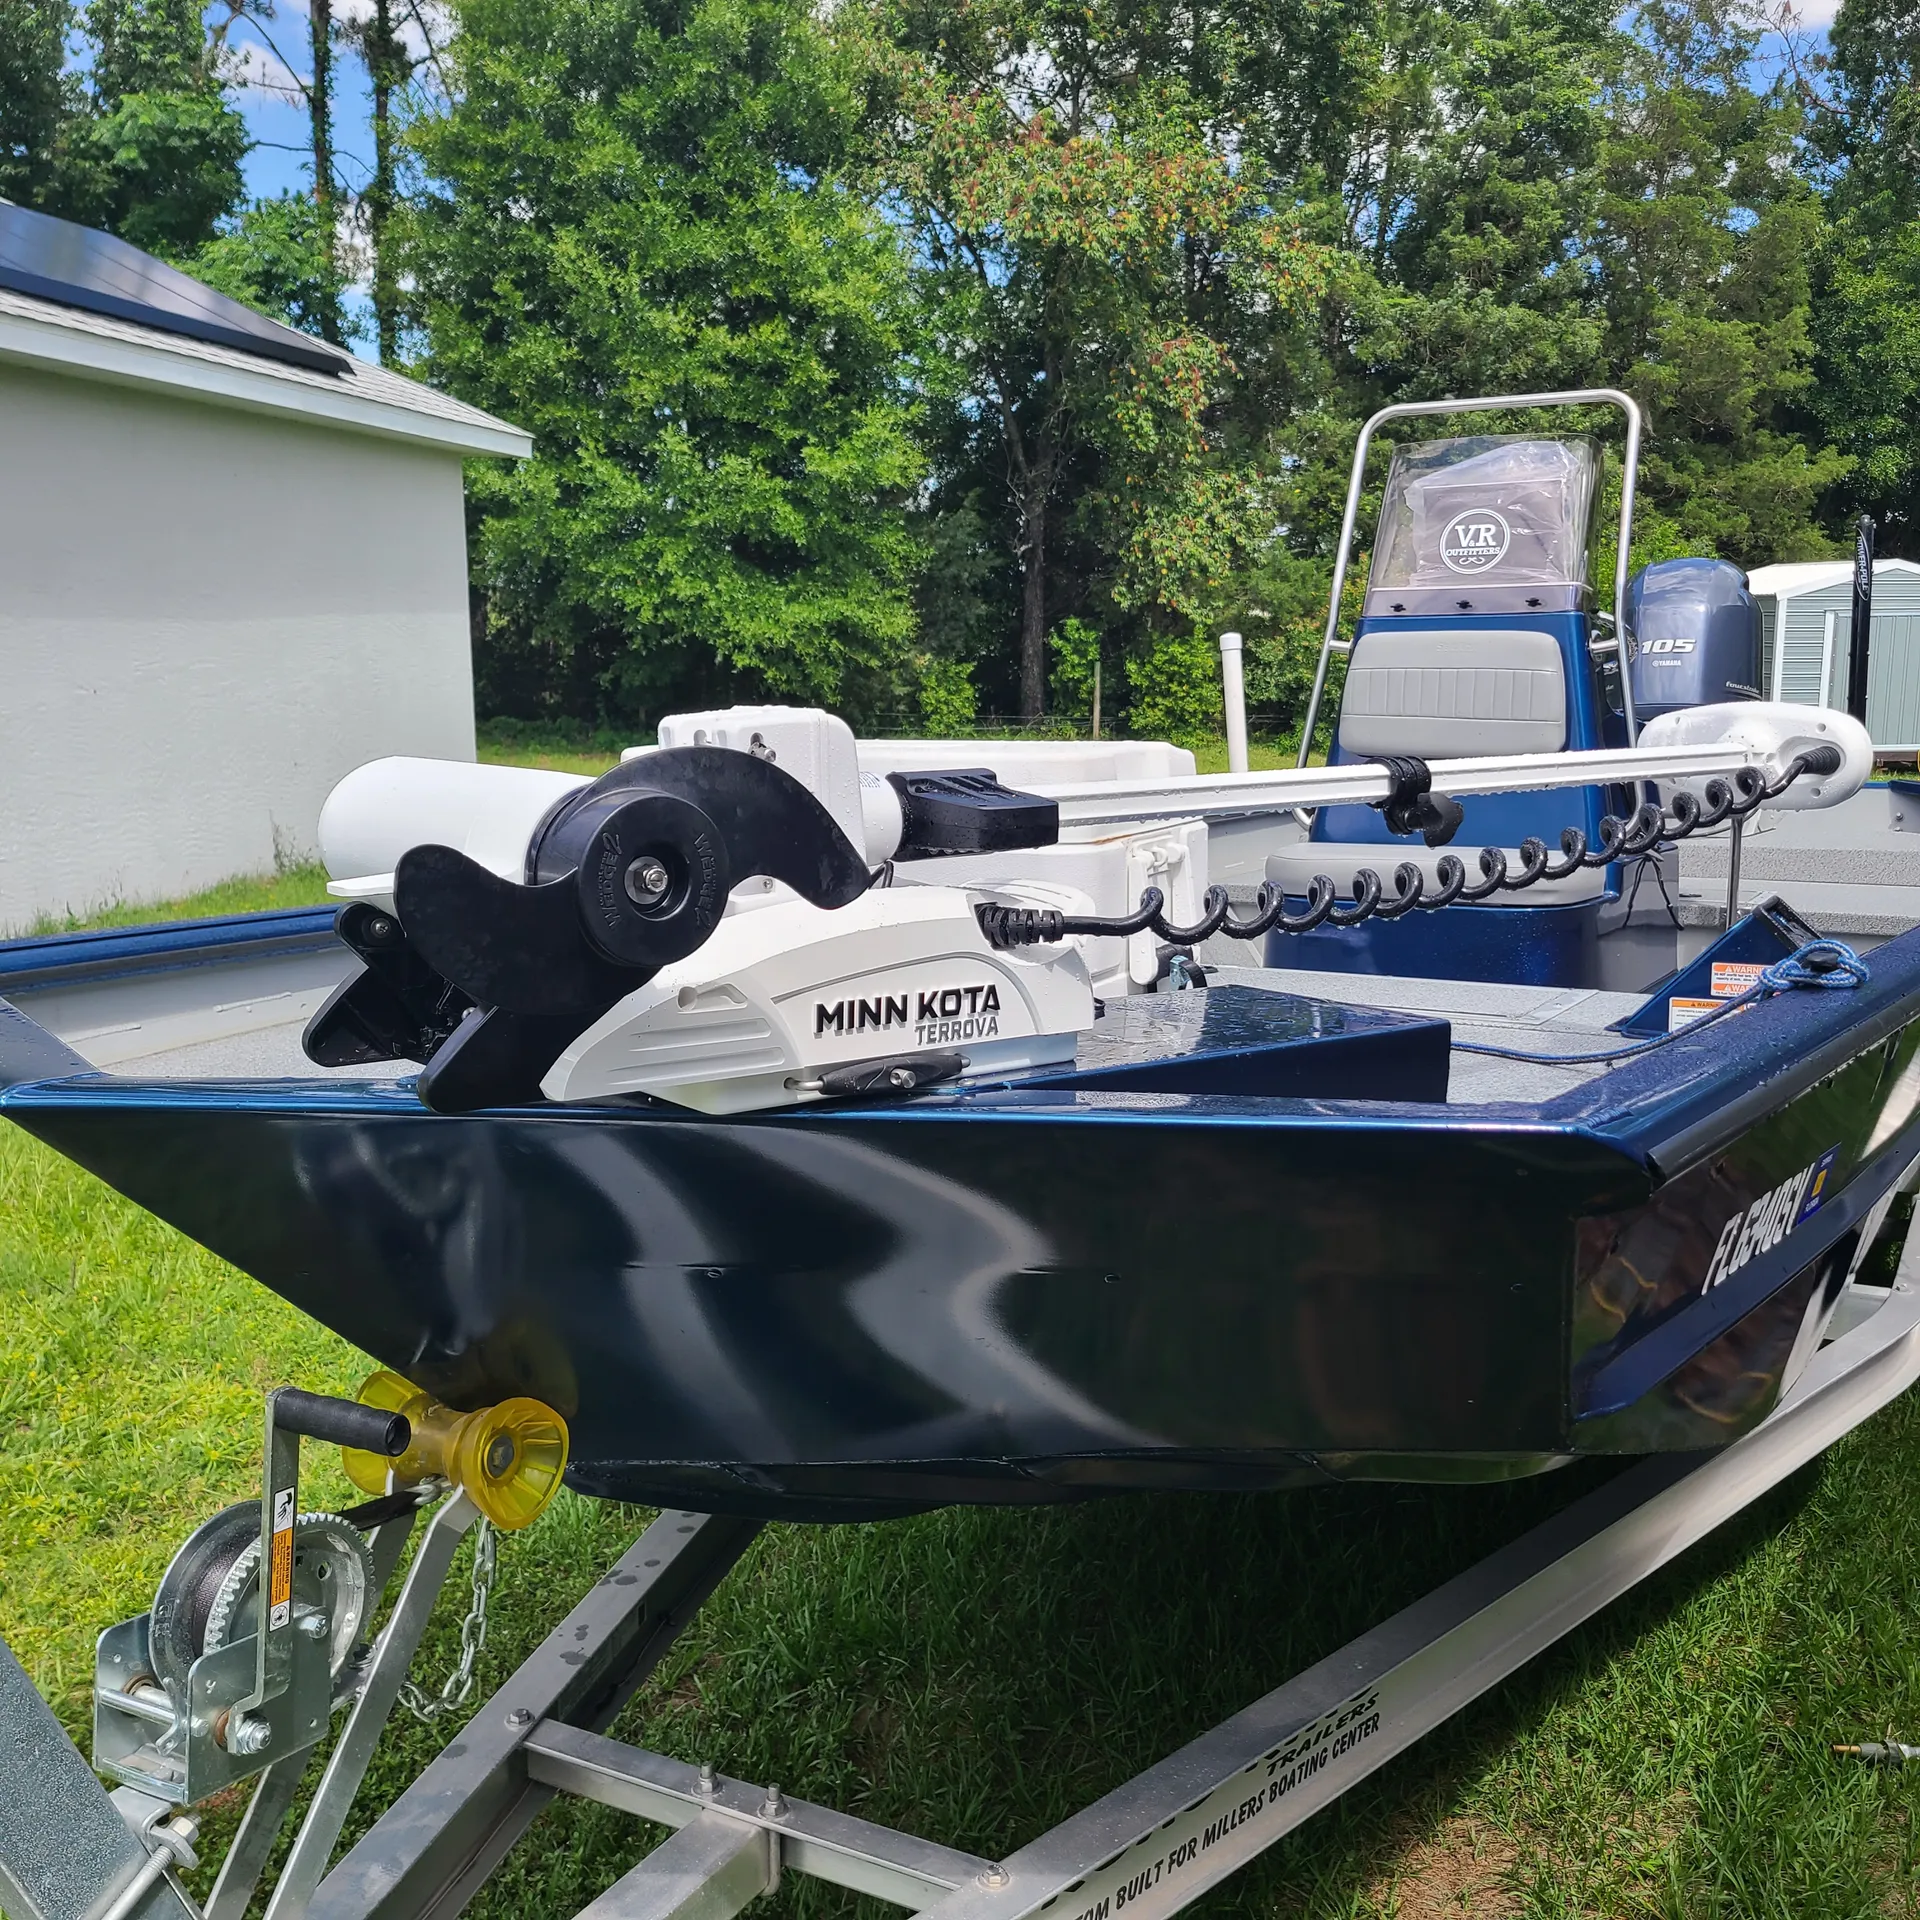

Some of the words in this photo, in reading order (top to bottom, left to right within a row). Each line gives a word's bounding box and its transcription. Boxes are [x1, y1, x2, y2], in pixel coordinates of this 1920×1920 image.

[1446, 547, 1501, 557] OUTFITTERS
[1641, 639, 1696, 655] 105
[1659, 659, 1682, 667] YAMAHA
[815, 994, 908, 1038] MINN
[916, 984, 1001, 1024] KOTA
[915, 1016, 999, 1046] TERROVA
[1266, 1692, 1379, 1777] TRAILERS
[1116, 1858, 1164, 1910] BUILT
[1168, 1837, 1197, 1874] FOR
[1202, 1788, 1266, 1850] MILLERS
[1268, 1747, 1328, 1804] BOATING
[1333, 1712, 1380, 1759] CENTER
